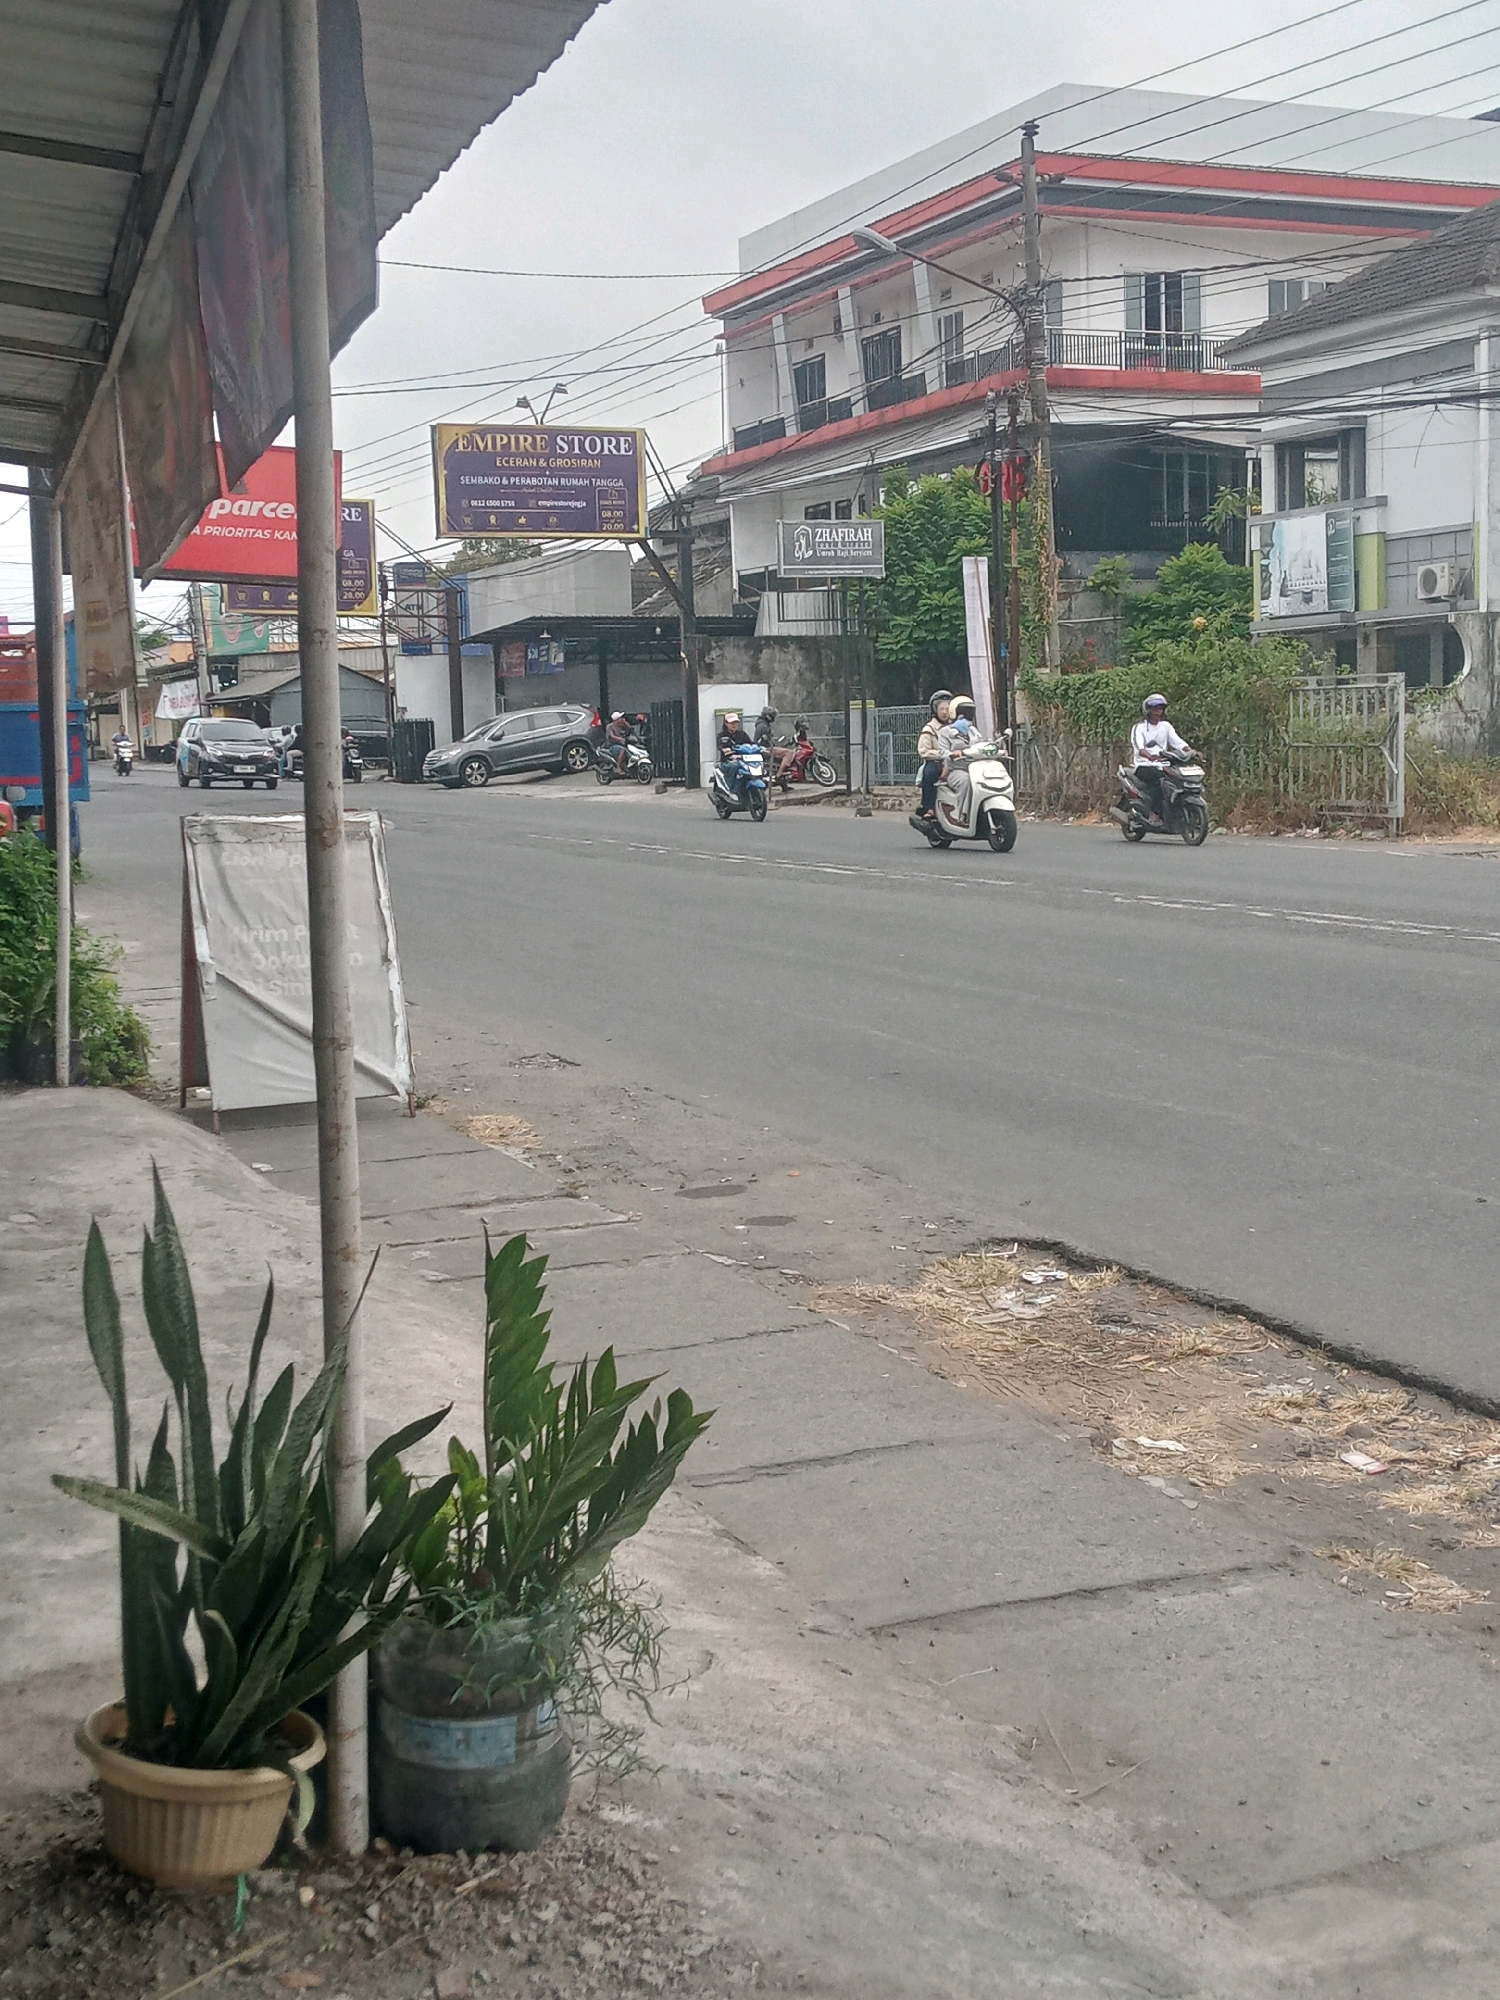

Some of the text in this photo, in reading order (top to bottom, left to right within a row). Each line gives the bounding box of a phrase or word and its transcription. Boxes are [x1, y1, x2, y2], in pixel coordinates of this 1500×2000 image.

[455, 433, 633, 455] EMPIRE STORE
[496, 457, 601, 468] ECERAN & GROSIRAN
[460, 475, 624, 487] SEMBAKO & PERABOTAN RUMAH TANGGA
[208, 498, 298, 519] parce
[538, 500, 587, 509] empirestorejogja
[601, 510, 624, 518] 08.00
[203, 525, 272, 538] PRIORITAS
[602, 523, 625, 531] 20.00
[815, 527, 873, 542] ZHAFIRAH
[341, 579, 365, 588] 08.00
[342, 591, 365, 600] 20.00
